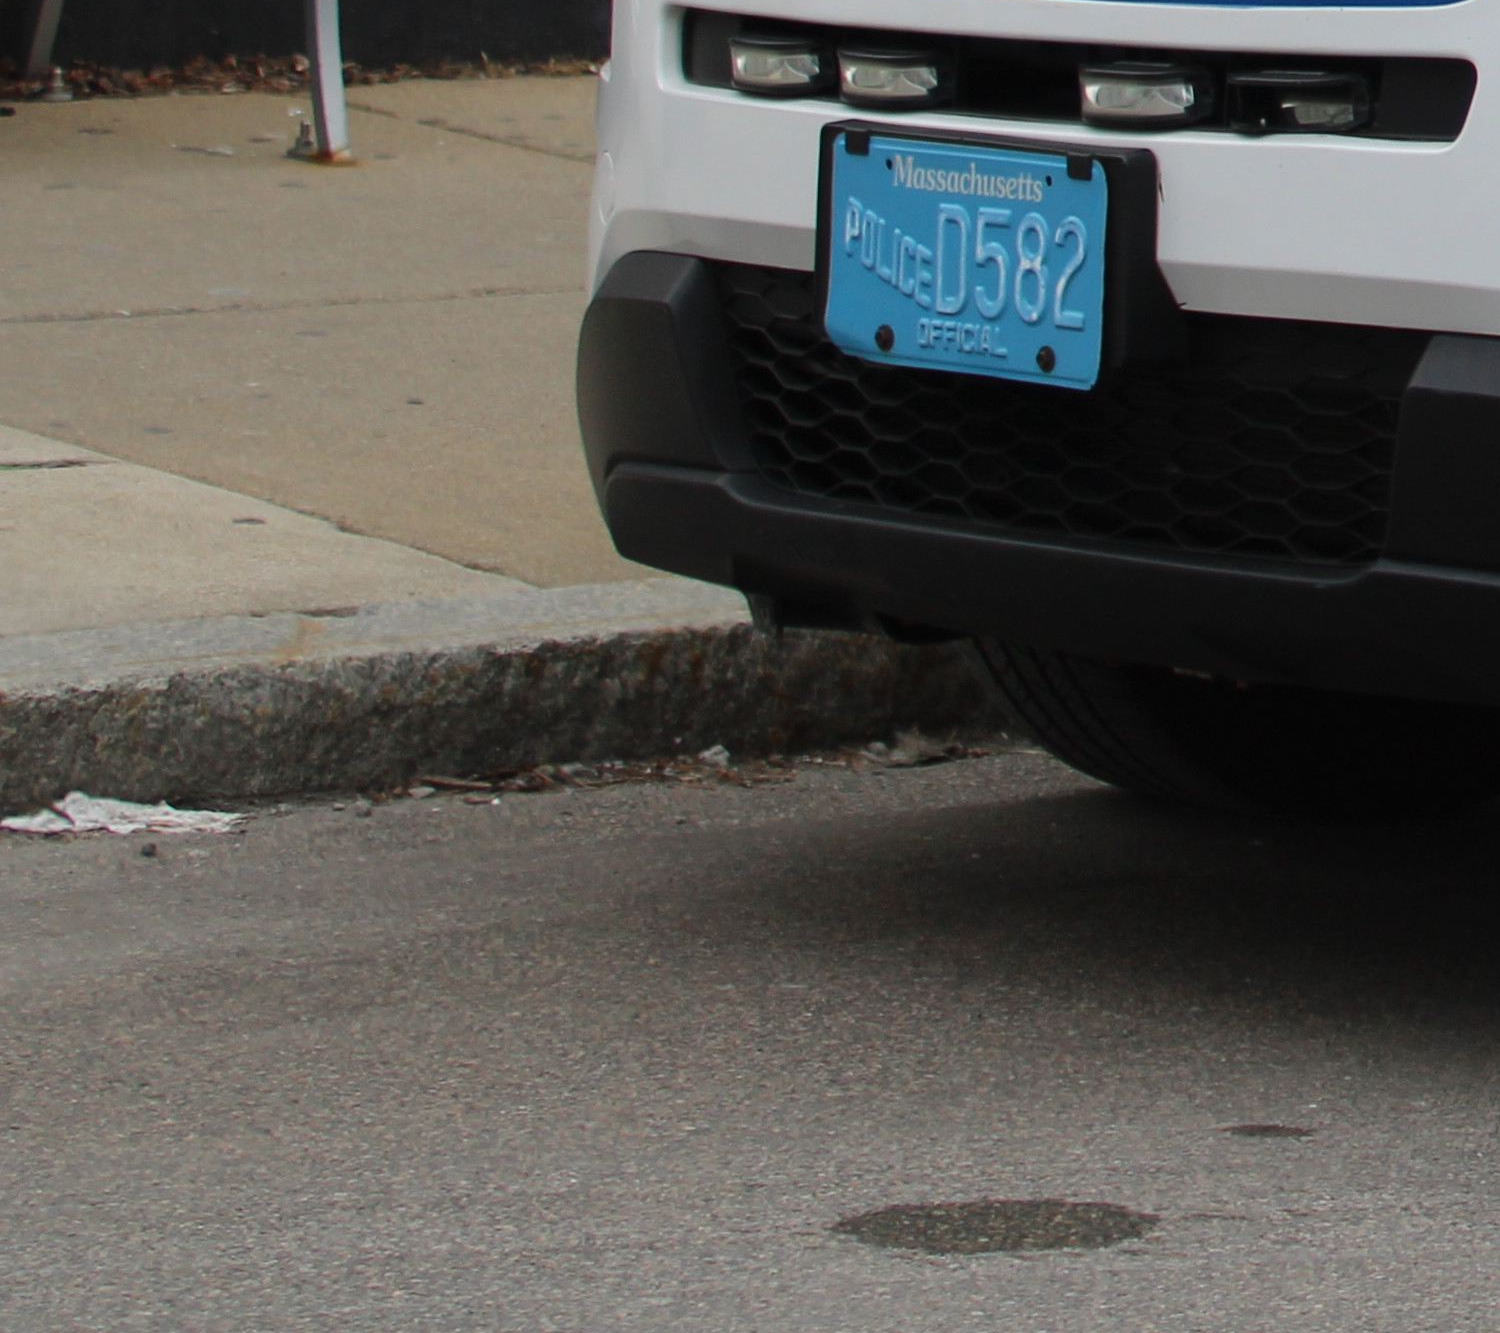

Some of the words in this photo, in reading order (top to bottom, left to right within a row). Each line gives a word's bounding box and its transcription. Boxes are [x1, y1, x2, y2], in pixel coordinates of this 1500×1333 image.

[893, 154, 1043, 203] Massachusetts
[845, 196, 933, 312] POLICE
[936, 202, 1088, 332] D582
[917, 317, 1009, 358] OFFICIAL
